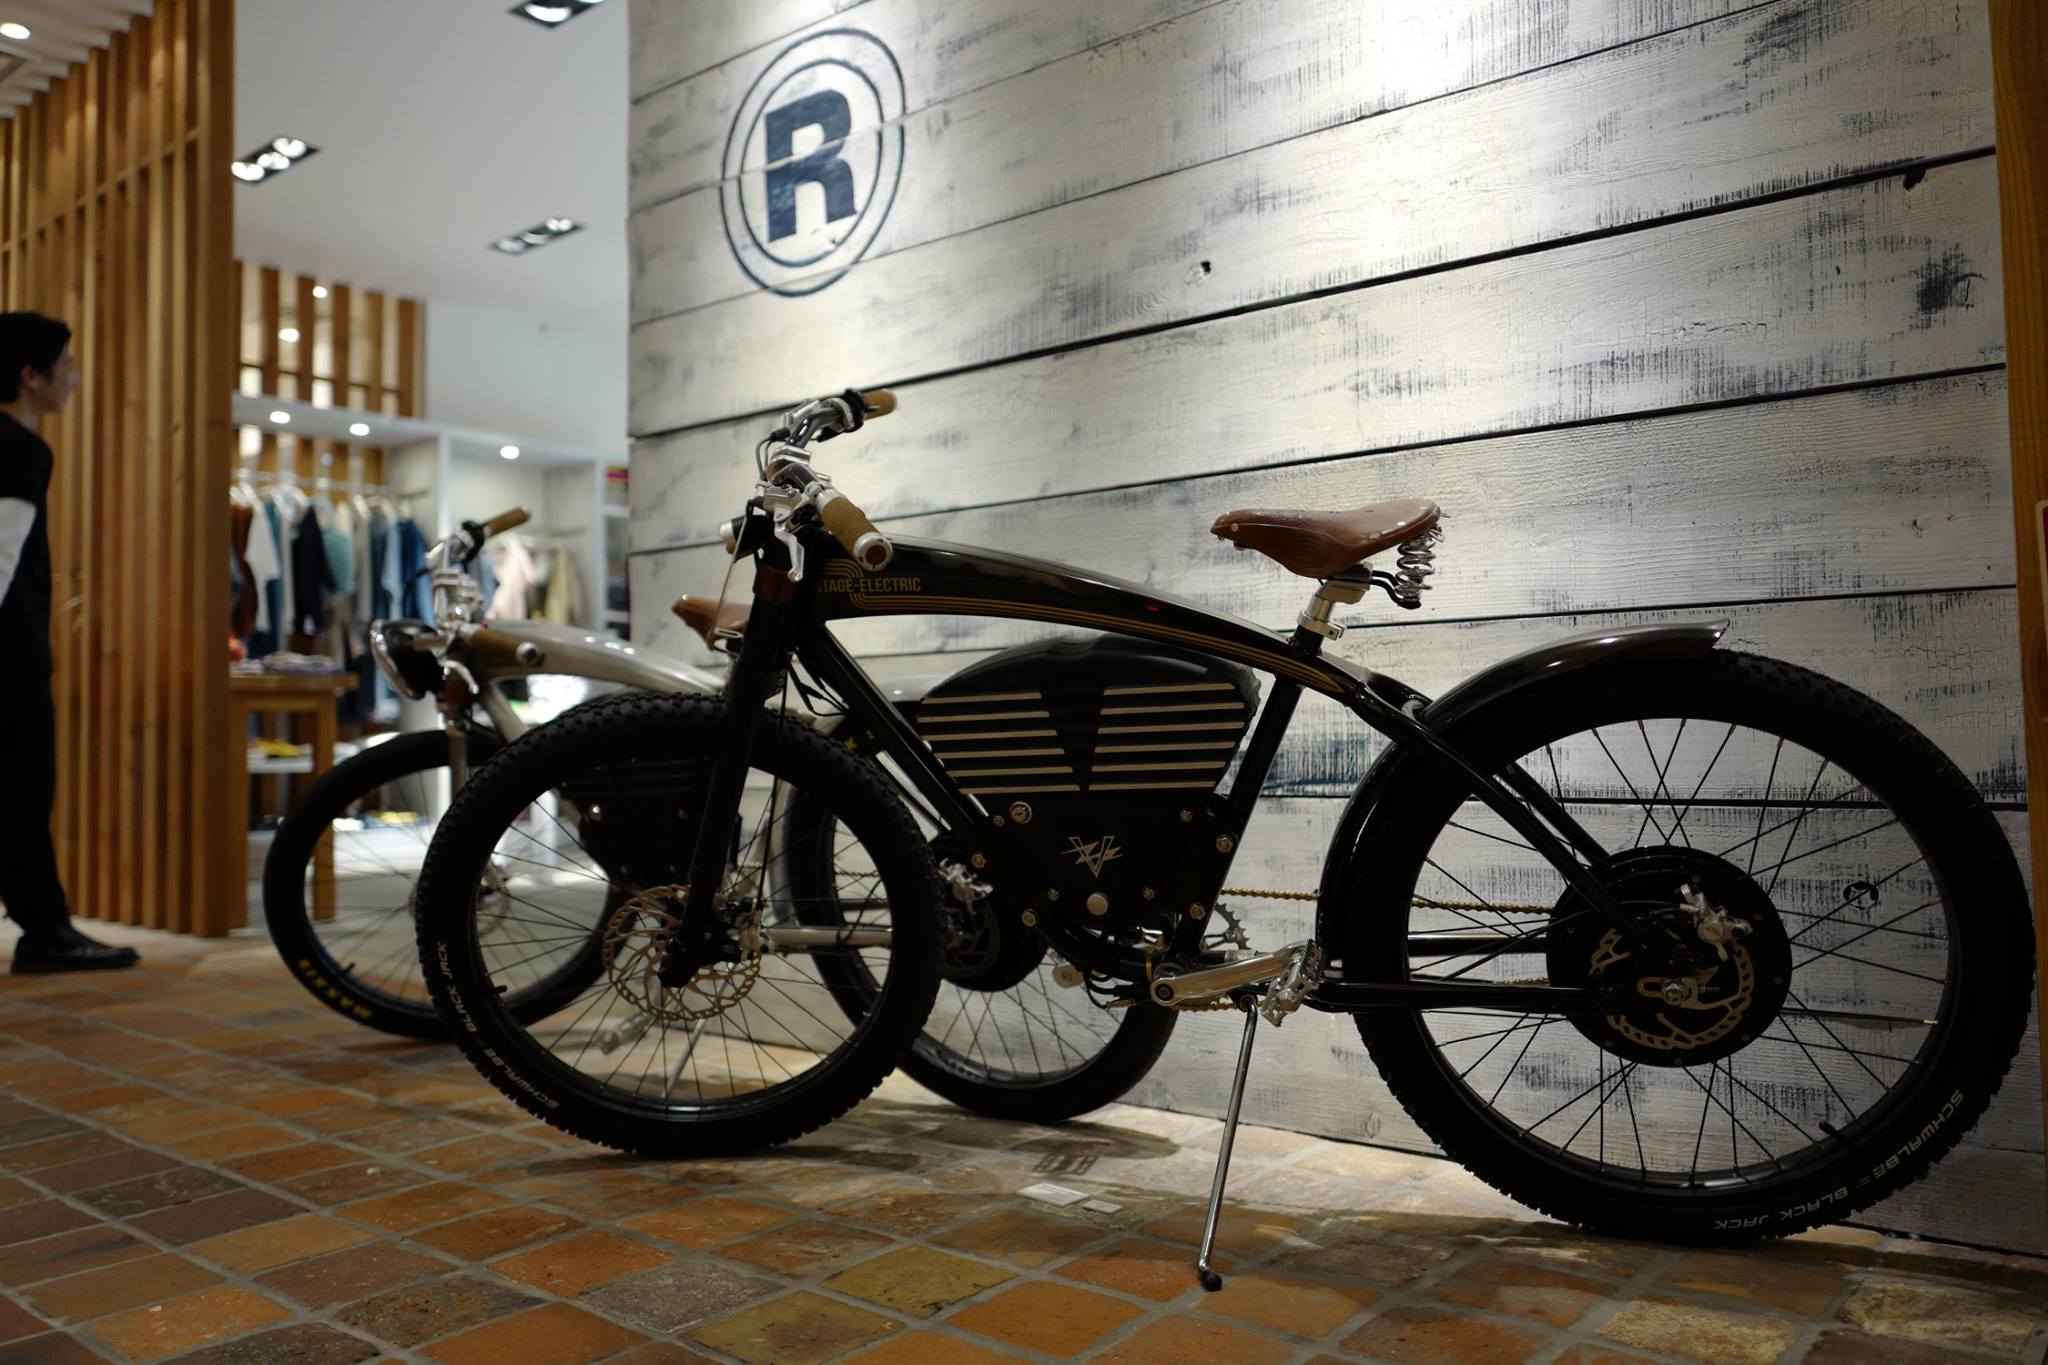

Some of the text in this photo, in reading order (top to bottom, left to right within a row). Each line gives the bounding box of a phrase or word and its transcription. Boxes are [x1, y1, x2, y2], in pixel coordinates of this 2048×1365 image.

[766, 89, 857, 243] R
[861, 577, 922, 593] ELECTRIC
[436, 941, 561, 1110] SCHWALBE BLACK JACK
[1712, 1088, 1966, 1231] SCHWALBE BLACK JACK
